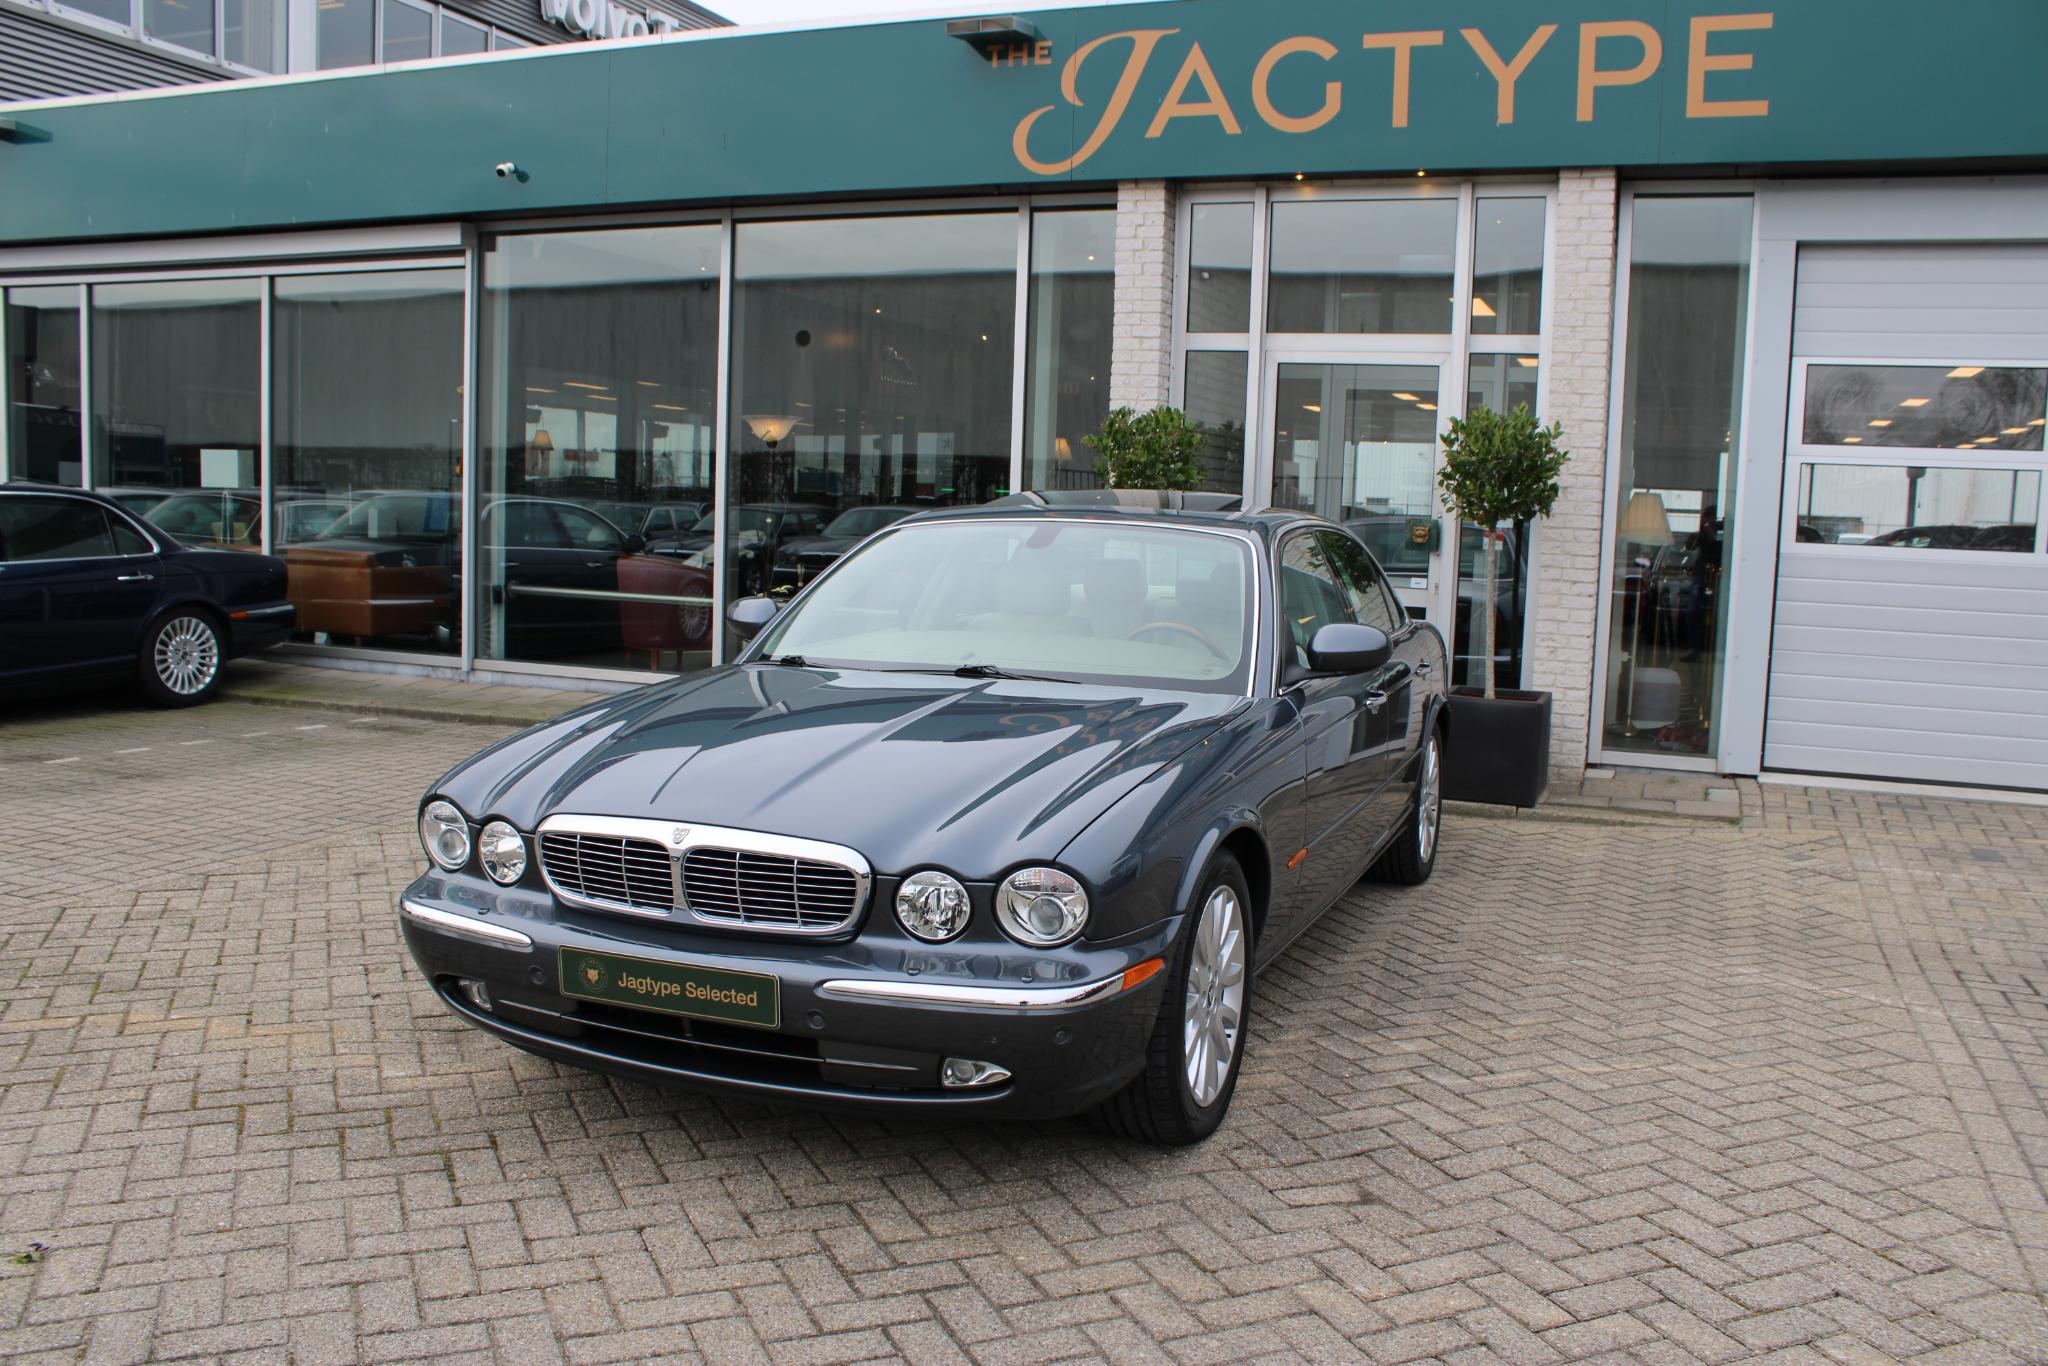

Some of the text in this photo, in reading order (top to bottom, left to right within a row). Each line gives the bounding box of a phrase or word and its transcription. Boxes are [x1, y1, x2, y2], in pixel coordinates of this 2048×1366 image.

[986, 41, 1053, 68] THE
[1013, 12, 1775, 176] JAGTYPE
[618, 972, 758, 1007] Jagtype Selected
